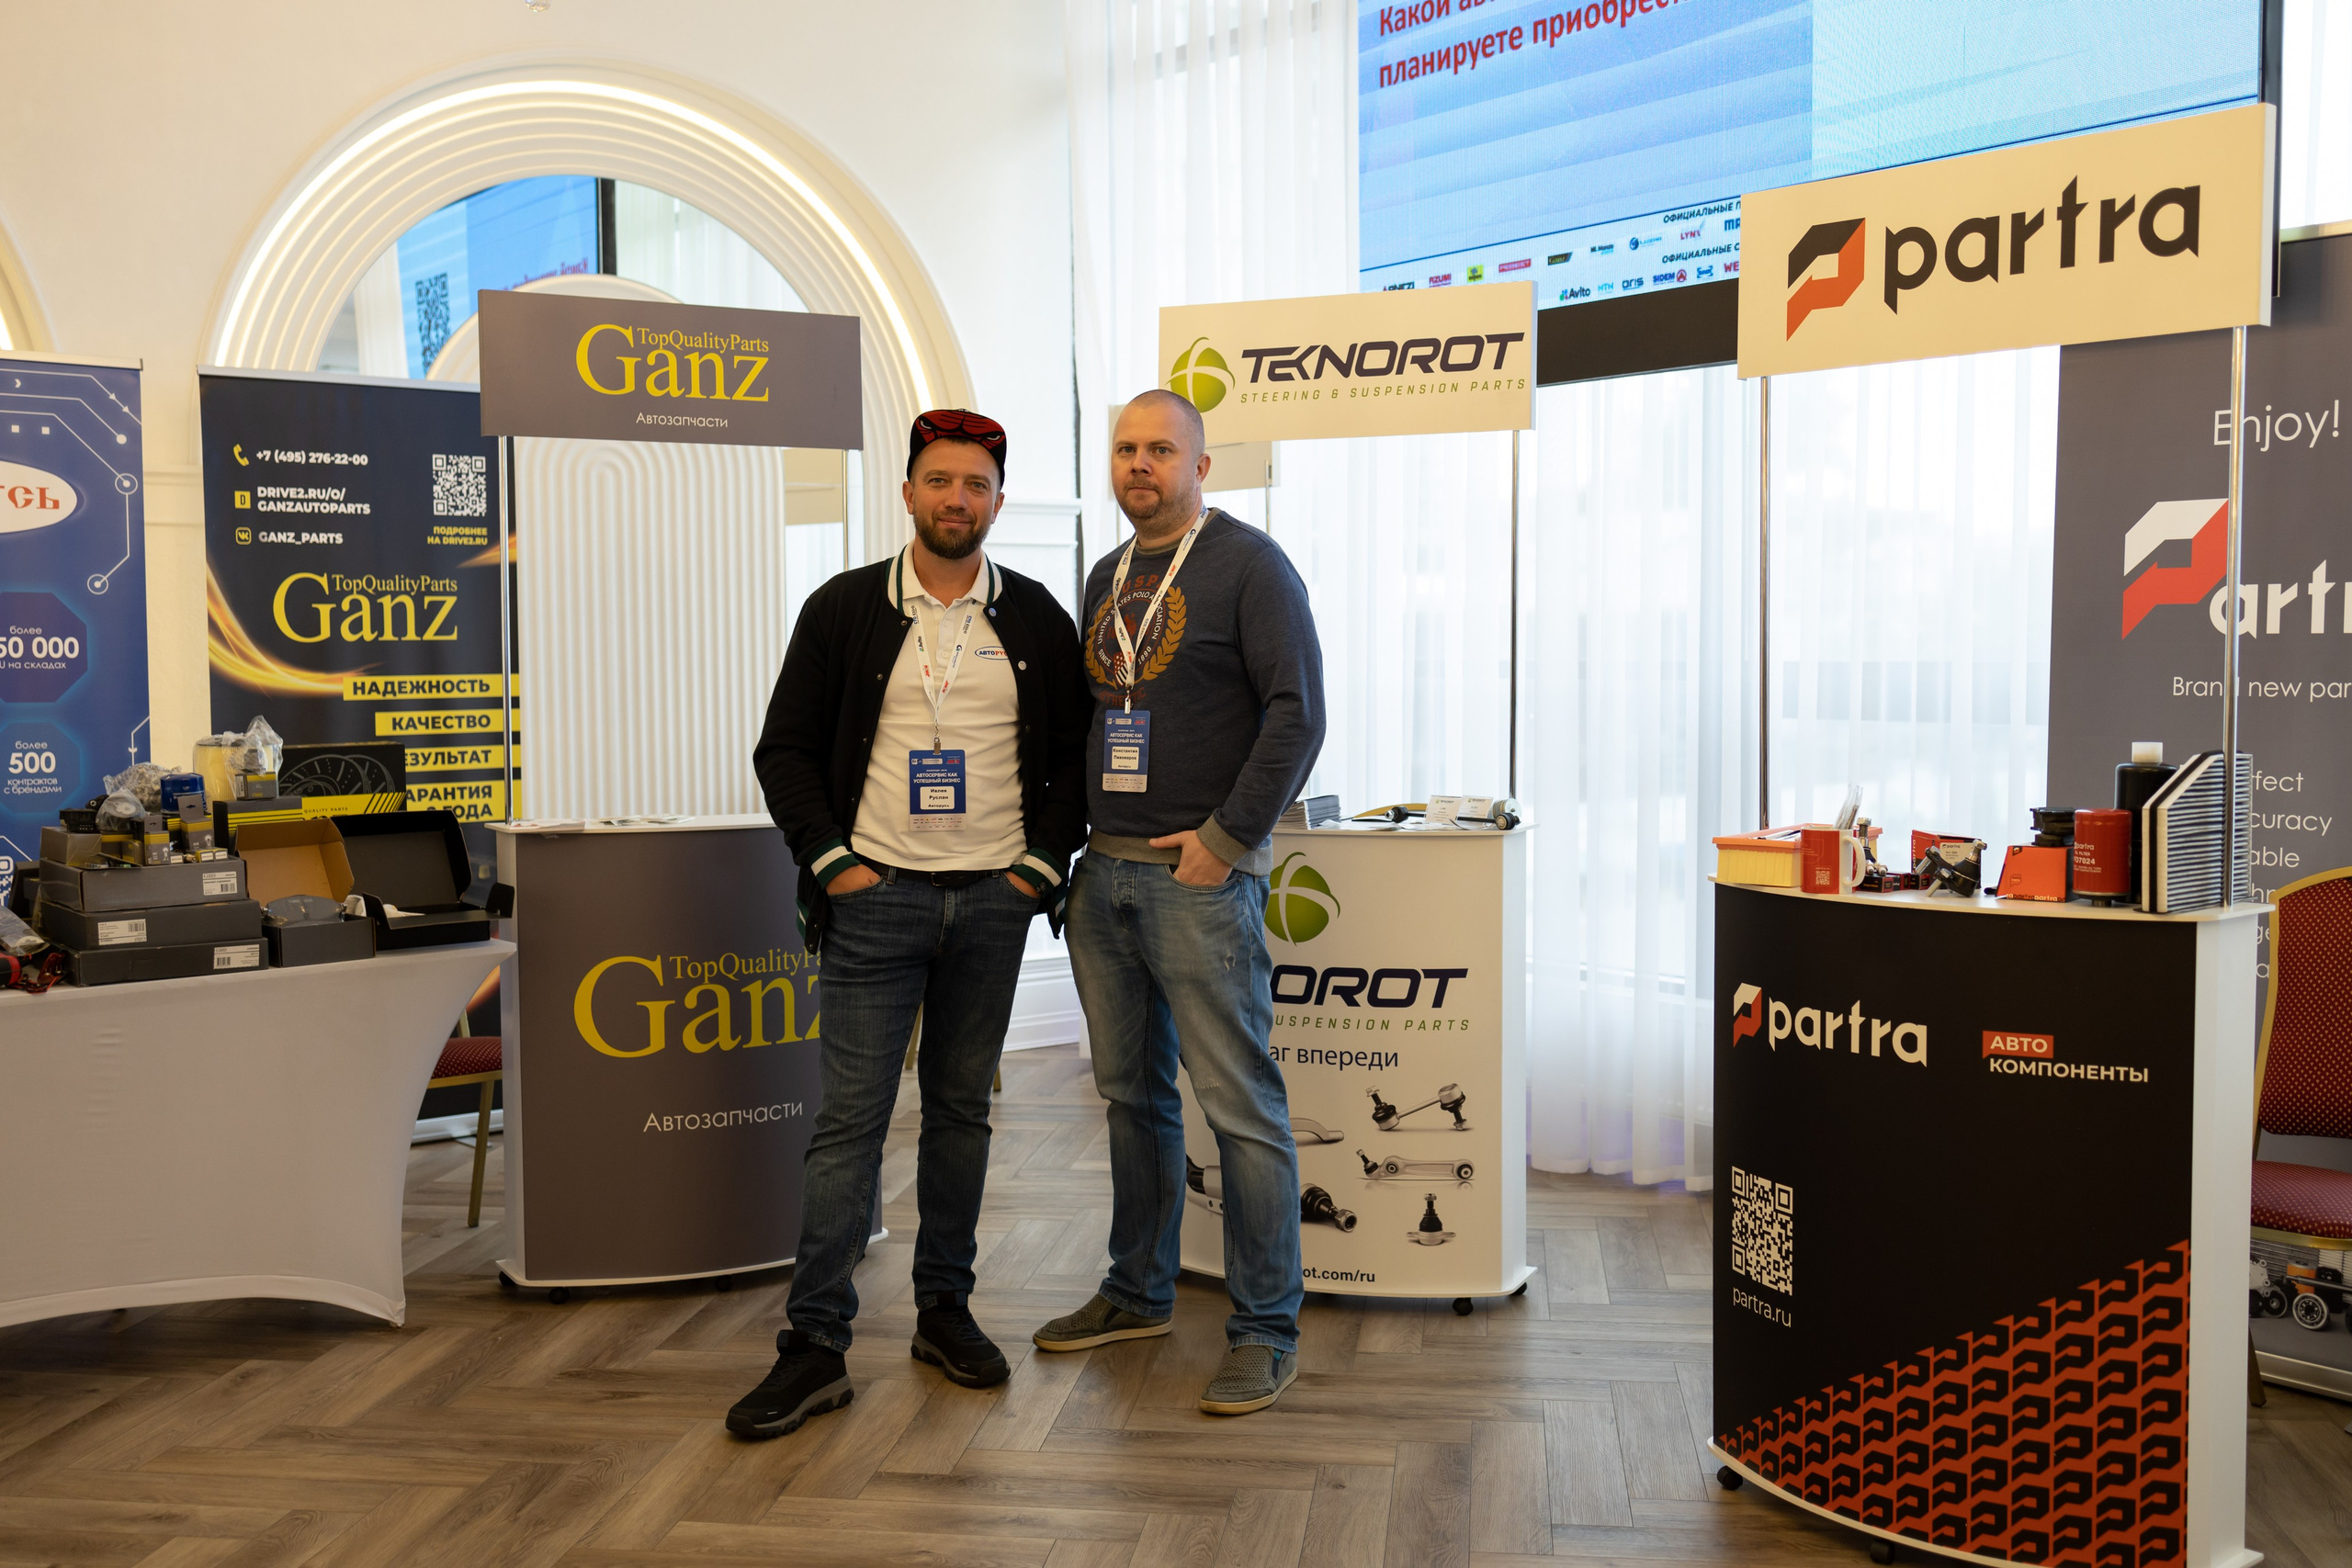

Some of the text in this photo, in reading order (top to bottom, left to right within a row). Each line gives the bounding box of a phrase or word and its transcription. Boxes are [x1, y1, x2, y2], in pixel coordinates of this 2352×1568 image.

[1380, 0, 1688, 88] планируете приобре
[1663, 201, 1734, 223] ОФИЦИАЛЬНЫЕ
[1662, 243, 1732, 264] ОФИЦИАЛЬНЫЕ
[1884, 175, 2200, 315] partra
[1569, 287, 1590, 299] Avito
[637, 327, 769, 354] TopQualityParts
[575, 323, 769, 401] Ganz
[1241, 332, 1525, 383] TEKNOROT
[1240, 378, 1526, 403] STEERING & SUSPENSION PARTS
[636, 412, 729, 429] Автозапчасти
[2213, 400, 2339, 452] Enjoy!
[256, 449, 368, 466] +7 (495) 276-22-00
[257, 486, 346, 502] DRIVE2.RU/O/
[257, 501, 371, 515] GANZAUTOPARTS
[258, 531, 344, 545] GANZ_PARTS
[427, 536, 488, 547] НА DRIVE2.RU
[433, 526, 488, 536] ПОДРОБНЕЕ
[332, 573, 458, 596] TopQualityParts
[273, 572, 458, 643] Ganz
[1097, 615, 1111, 645] UNITED
[1132, 591, 1150, 599] POLO
[9, 626, 42, 635] более
[31, 637, 80, 660] 000
[1098, 646, 1152, 667] SINCE 1890
[24, 661, 66, 670] складах
[353, 679, 491, 697] НАДЕЖНОСТЬ
[2173, 676, 2240, 697] Bran
[2248, 682, 2302, 698] new
[391, 714, 491, 731] КАЧЕСТВО
[15, 740, 48, 750] более
[8, 751, 56, 773] 500
[405, 750, 492, 766] ЗУЛЬТАТ
[7, 778, 58, 787] контрактов
[11, 784, 62, 795] брендами
[2251, 770, 2304, 792] fect
[406, 784, 492, 803] АРАНТИЯ
[443, 804, 492, 819] ОДА
[2250, 811, 2333, 836] curacy
[2250, 847, 2300, 868] able
[1270, 964, 1468, 1009] OROT
[1274, 1015, 1470, 1032] USPENSION PARTS
[1769, 997, 1928, 1067] partra
[1990, 1035, 2049, 1054] АВТО
[1269, 1046, 1399, 1072] аг впереди
[1989, 1057, 2149, 1083] КОМПОНЕНТЫ
[643, 1101, 803, 1133] Автозапчасти
[1302, 1269, 1376, 1284] ot.com/ru
[1733, 1285, 1792, 1328] partra.ru
